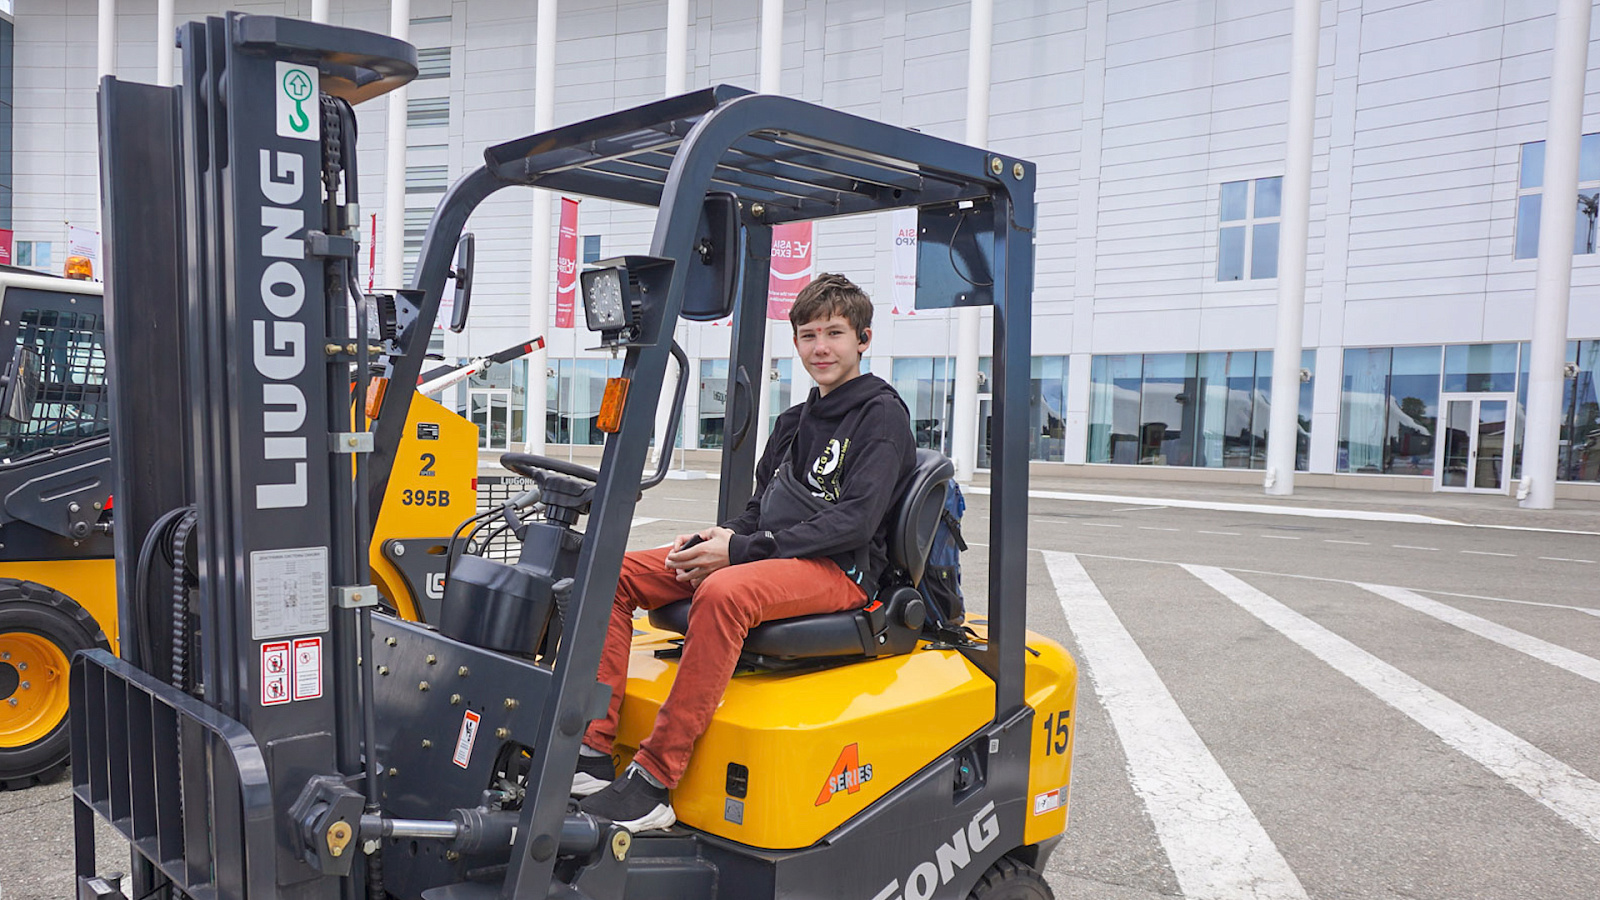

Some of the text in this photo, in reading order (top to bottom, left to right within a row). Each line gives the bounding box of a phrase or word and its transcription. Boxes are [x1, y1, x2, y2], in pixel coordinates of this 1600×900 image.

[419, 452, 436, 476] 2
[401, 489, 450, 507] 395B
[1043, 709, 1070, 757] 15
[828, 763, 873, 794] SERIES
